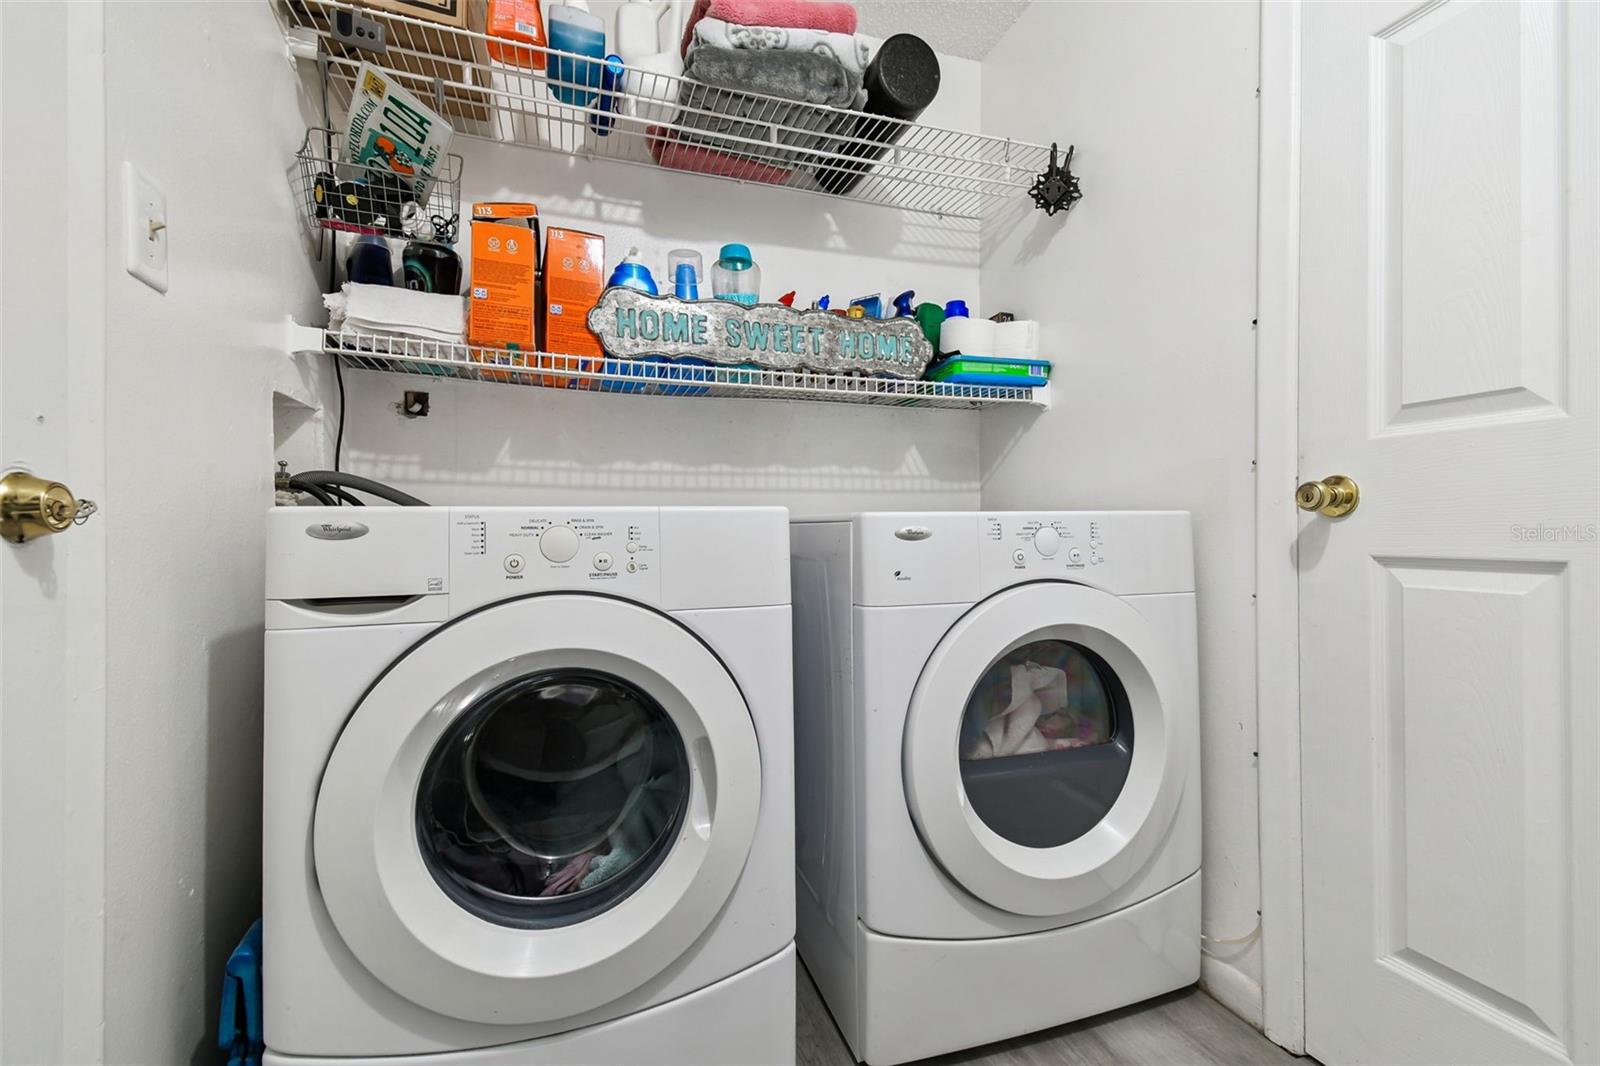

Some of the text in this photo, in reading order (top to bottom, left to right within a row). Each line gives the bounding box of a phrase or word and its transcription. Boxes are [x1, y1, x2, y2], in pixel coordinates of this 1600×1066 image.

[477, 207, 492, 215] 113
[550, 230, 564, 239] 113
[615, 306, 707, 345] HOME
[725, 317, 824, 356] SWEET
[839, 330, 914, 364] HOME
